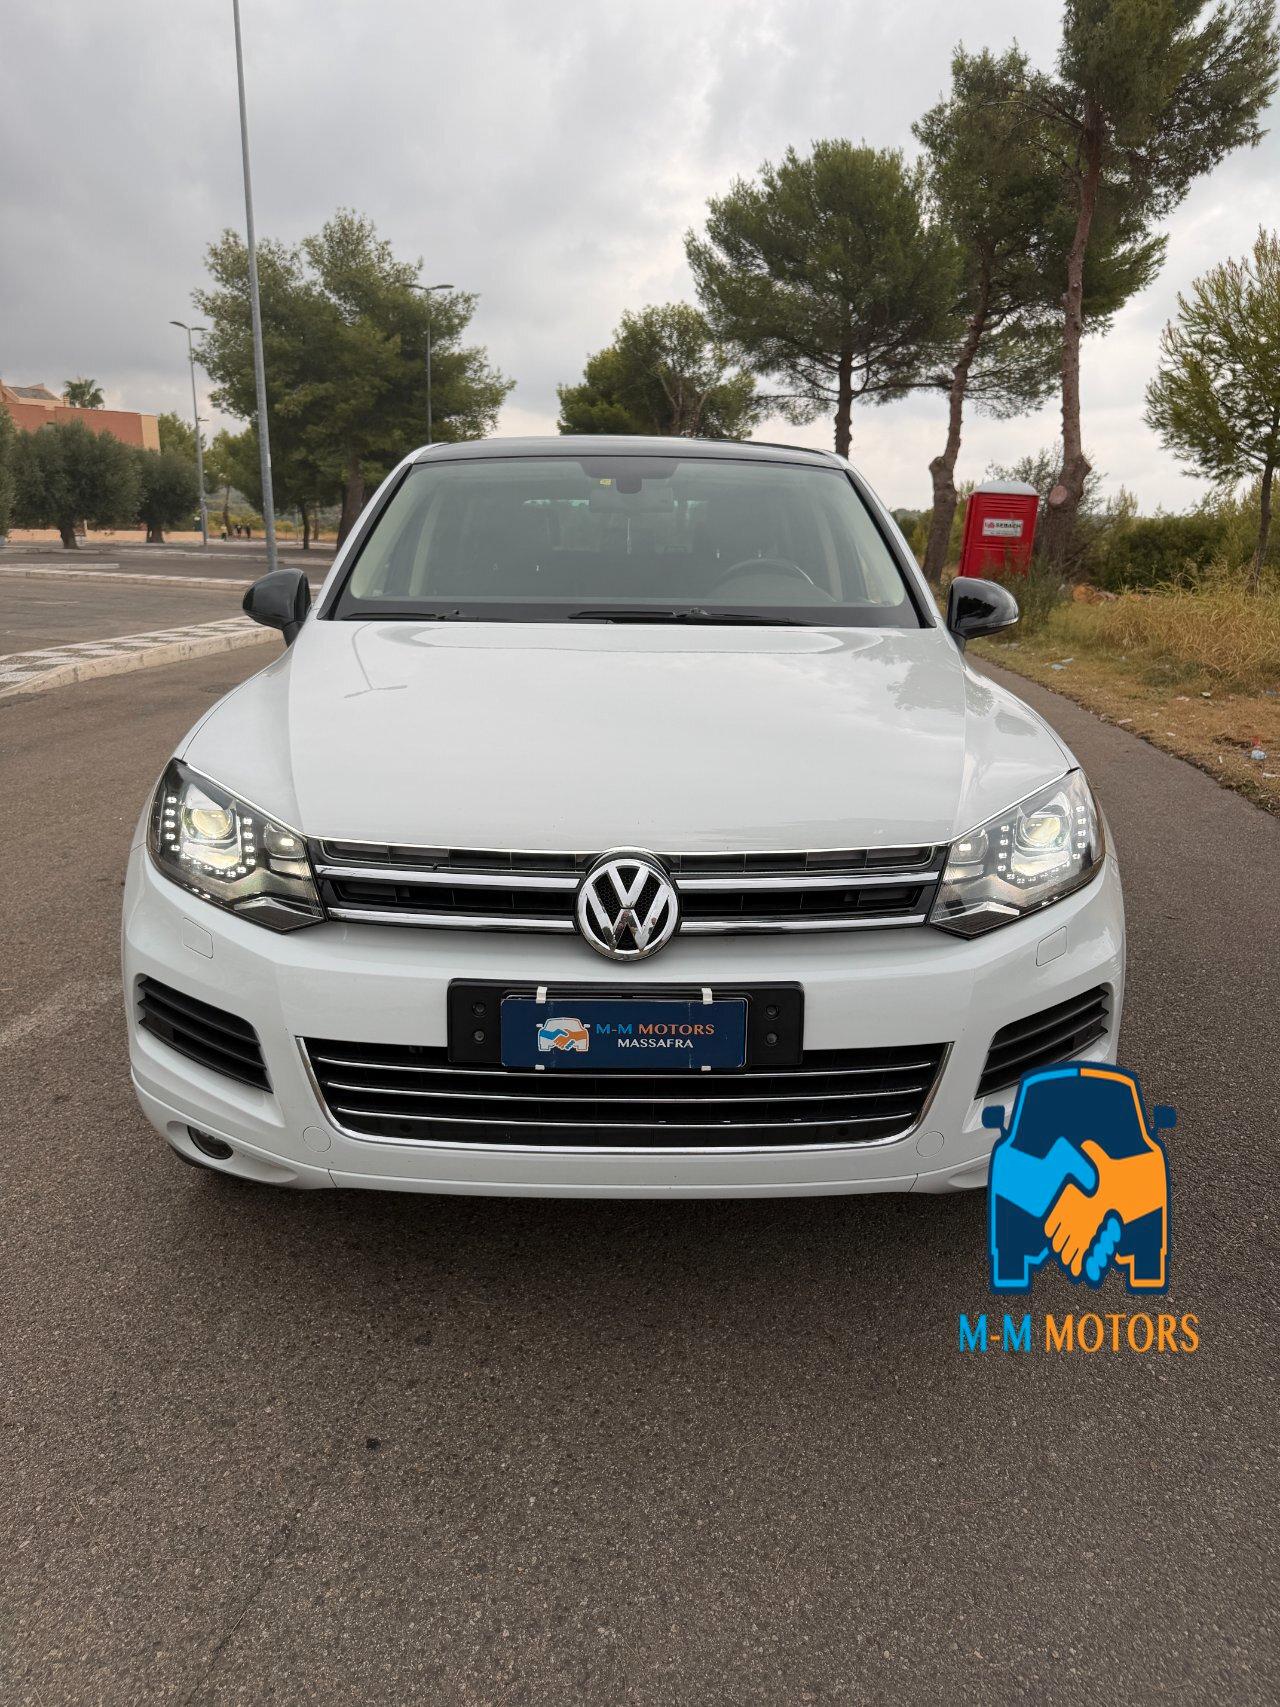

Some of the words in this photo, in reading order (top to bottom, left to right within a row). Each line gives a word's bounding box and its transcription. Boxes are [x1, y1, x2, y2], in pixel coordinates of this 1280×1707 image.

[580, 859, 677, 957] VW
[595, 1023, 633, 1035] M-M
[638, 1023, 715, 1035] MOTORS
[617, 1038, 694, 1048] MASSAFRA
